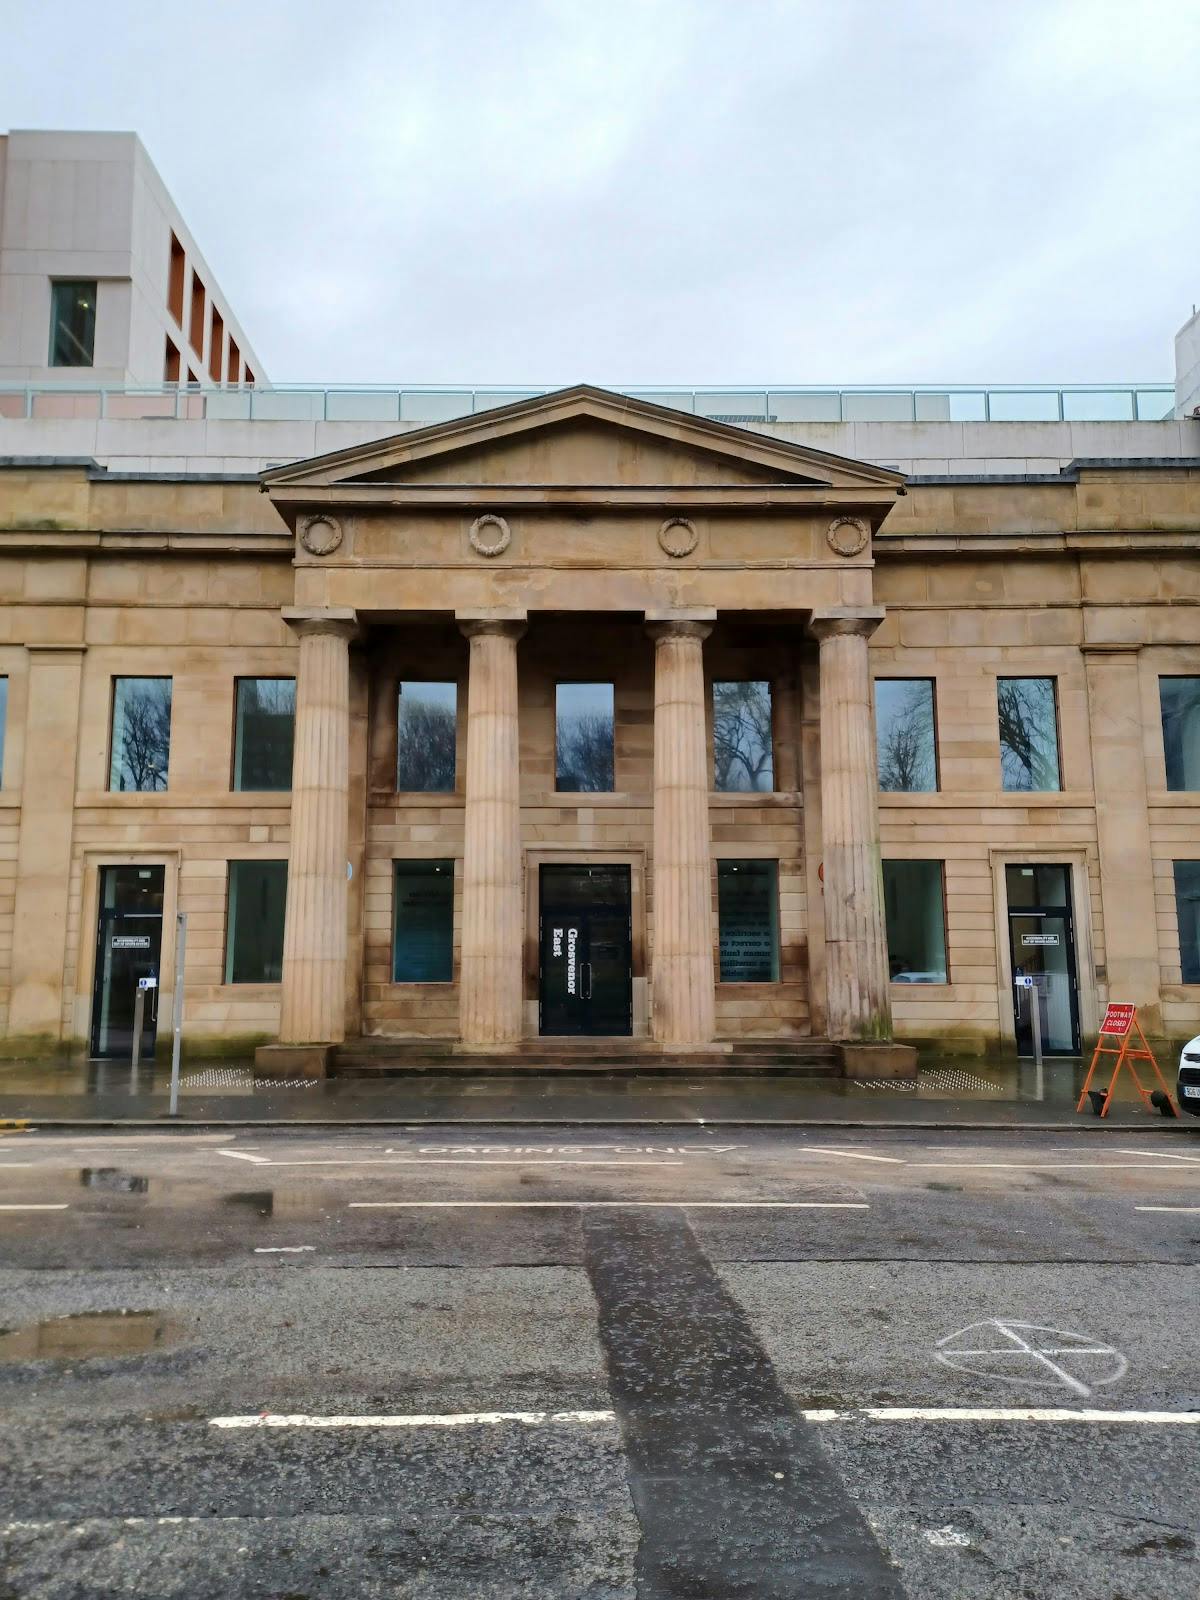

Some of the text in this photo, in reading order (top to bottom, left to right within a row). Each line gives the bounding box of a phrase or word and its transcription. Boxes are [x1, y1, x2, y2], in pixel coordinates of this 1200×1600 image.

[553, 928, 563, 957] East
[568, 928, 578, 994] Grosvenor
[1105, 1011, 1132, 1019] FOOTWAY
[1106, 1019, 1127, 1027] CLOSED
[614, 1146, 737, 1154] ONLY
